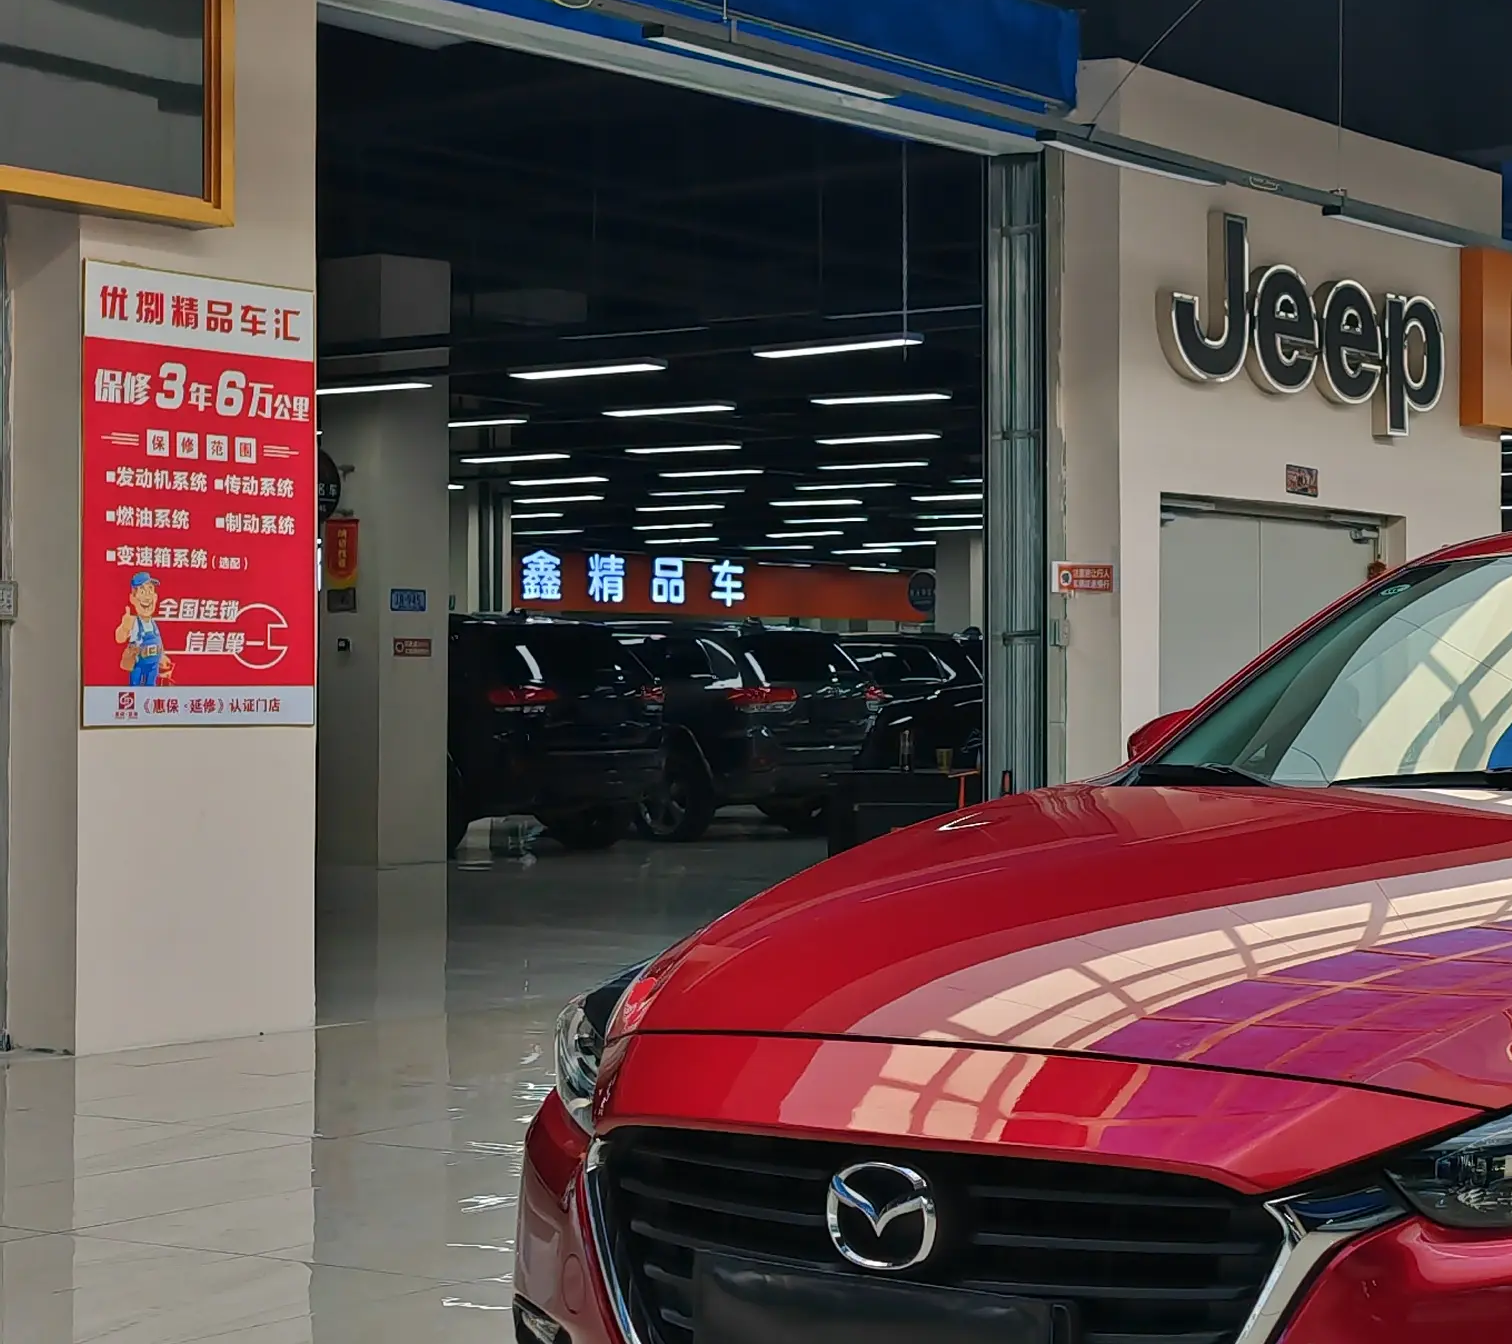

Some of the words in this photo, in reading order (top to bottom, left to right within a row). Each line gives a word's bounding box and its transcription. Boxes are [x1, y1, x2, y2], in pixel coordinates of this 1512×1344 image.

[100, 285, 300, 342] 优捌精品车汇
[1166, 211, 1446, 437] Jeep
[94, 361, 310, 422] 保修3年6万公里
[116, 466, 208, 493] 发动机系统
[224, 474, 295, 499] 传动系统
[116, 505, 190, 530] 燃油系统
[225, 512, 296, 536] 制动系统
[521, 549, 745, 607] 鑫精品车
[158, 598, 240, 621] 全国连锁
